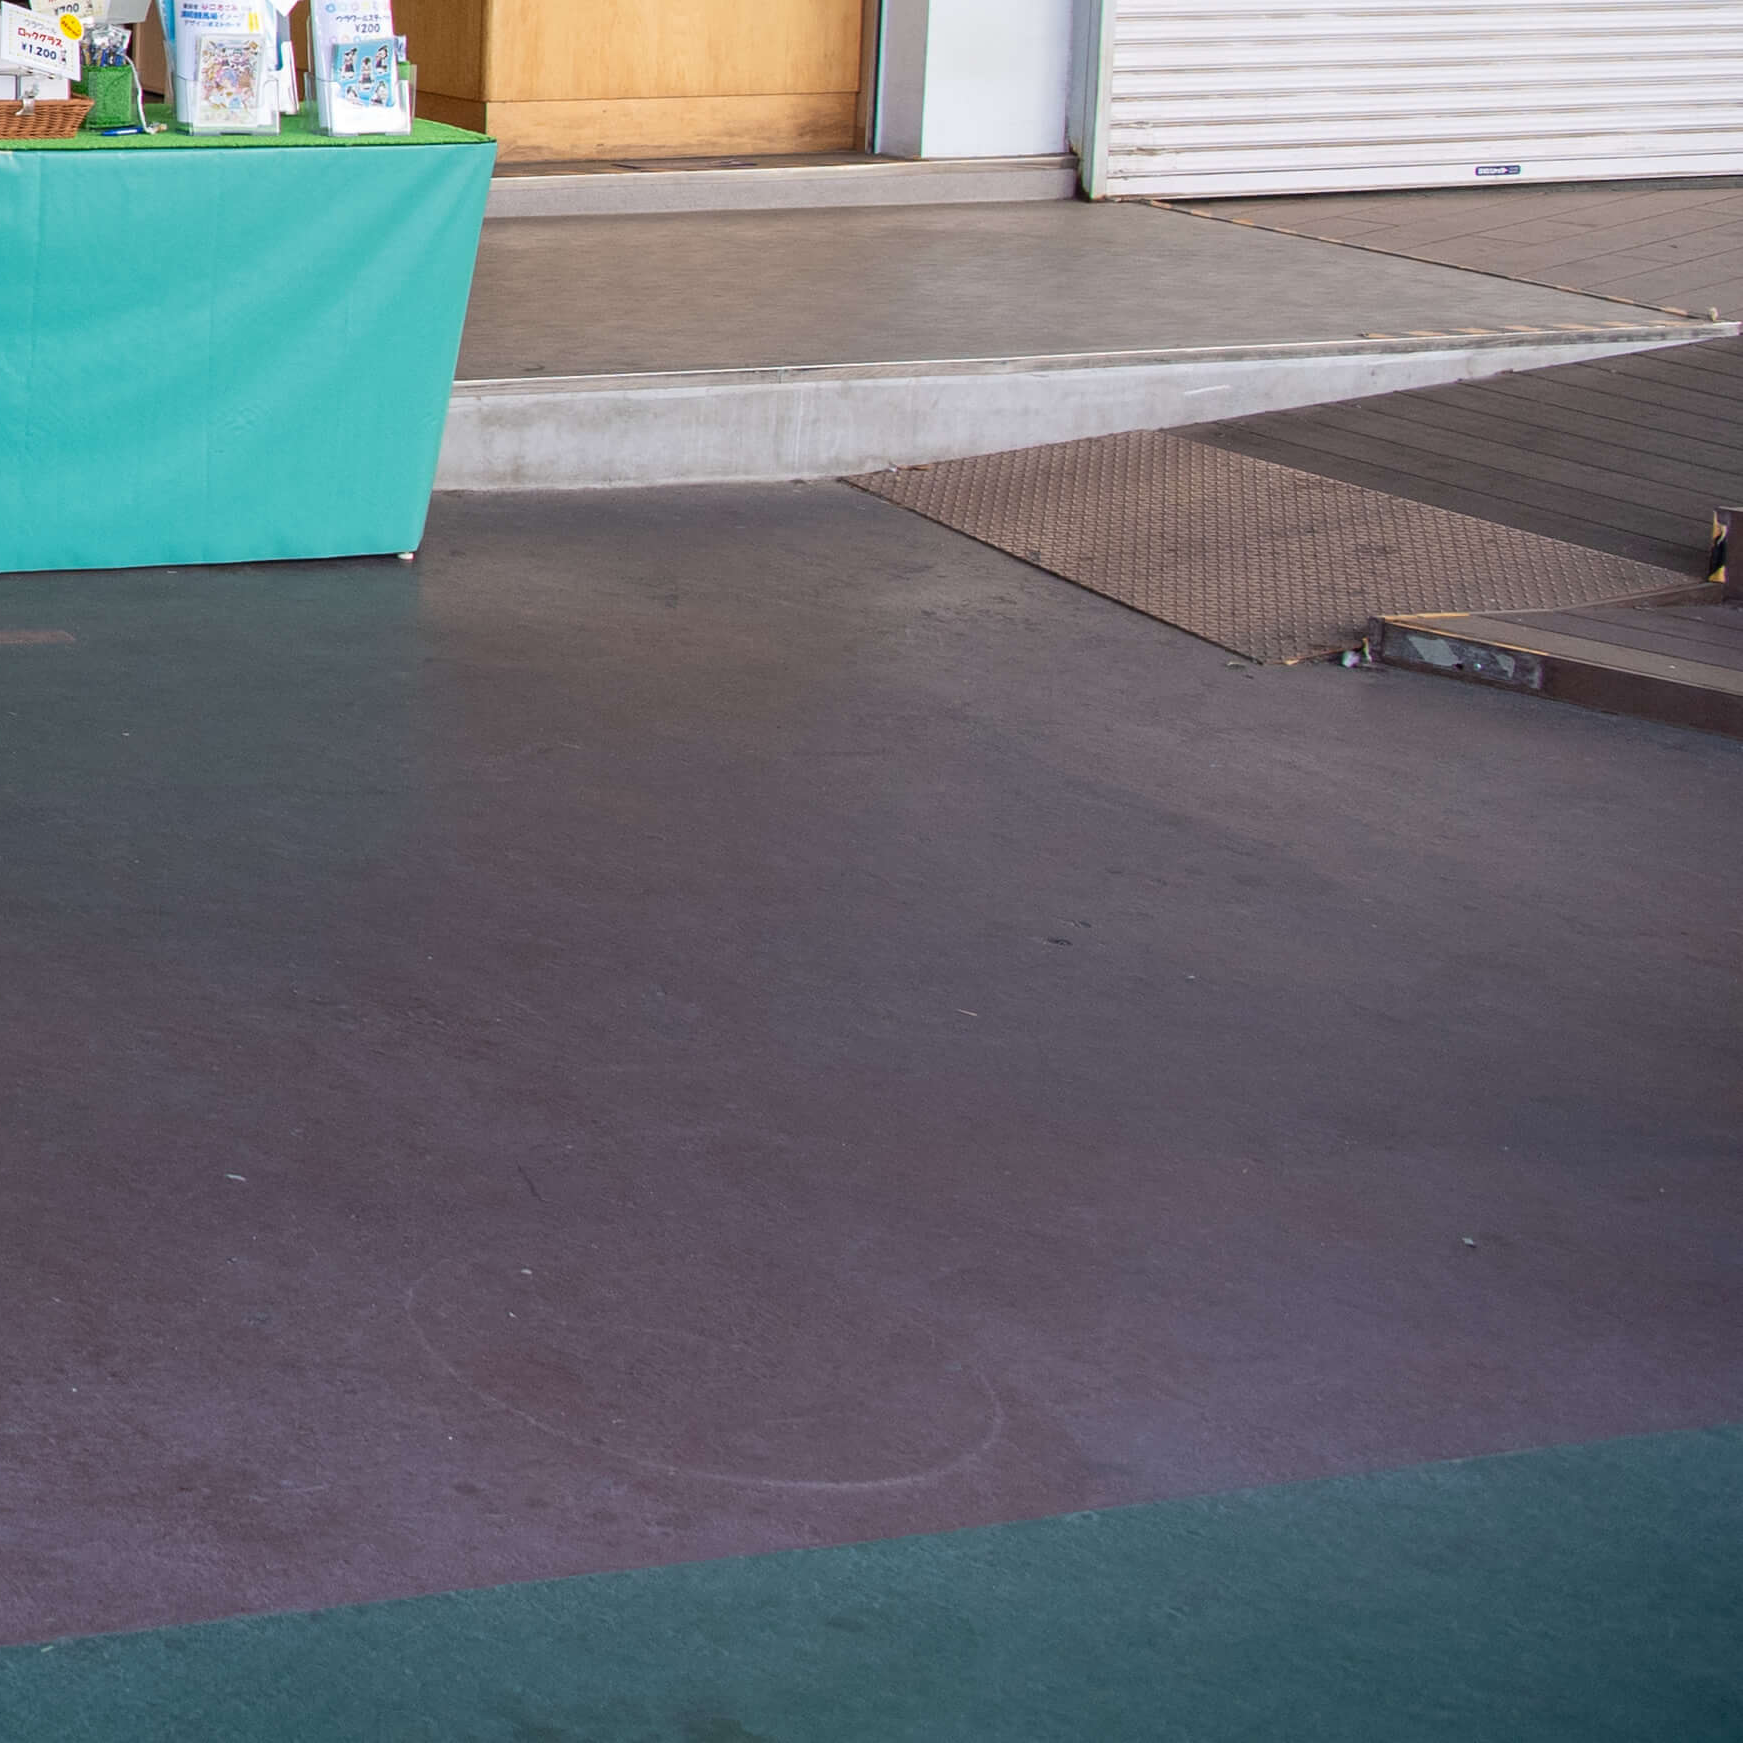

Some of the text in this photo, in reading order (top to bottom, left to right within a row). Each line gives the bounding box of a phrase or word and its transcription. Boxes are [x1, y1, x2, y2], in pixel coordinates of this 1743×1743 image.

[355, 23, 381, 33] ¥200
[17, 27, 63, 48] ロックグラス
